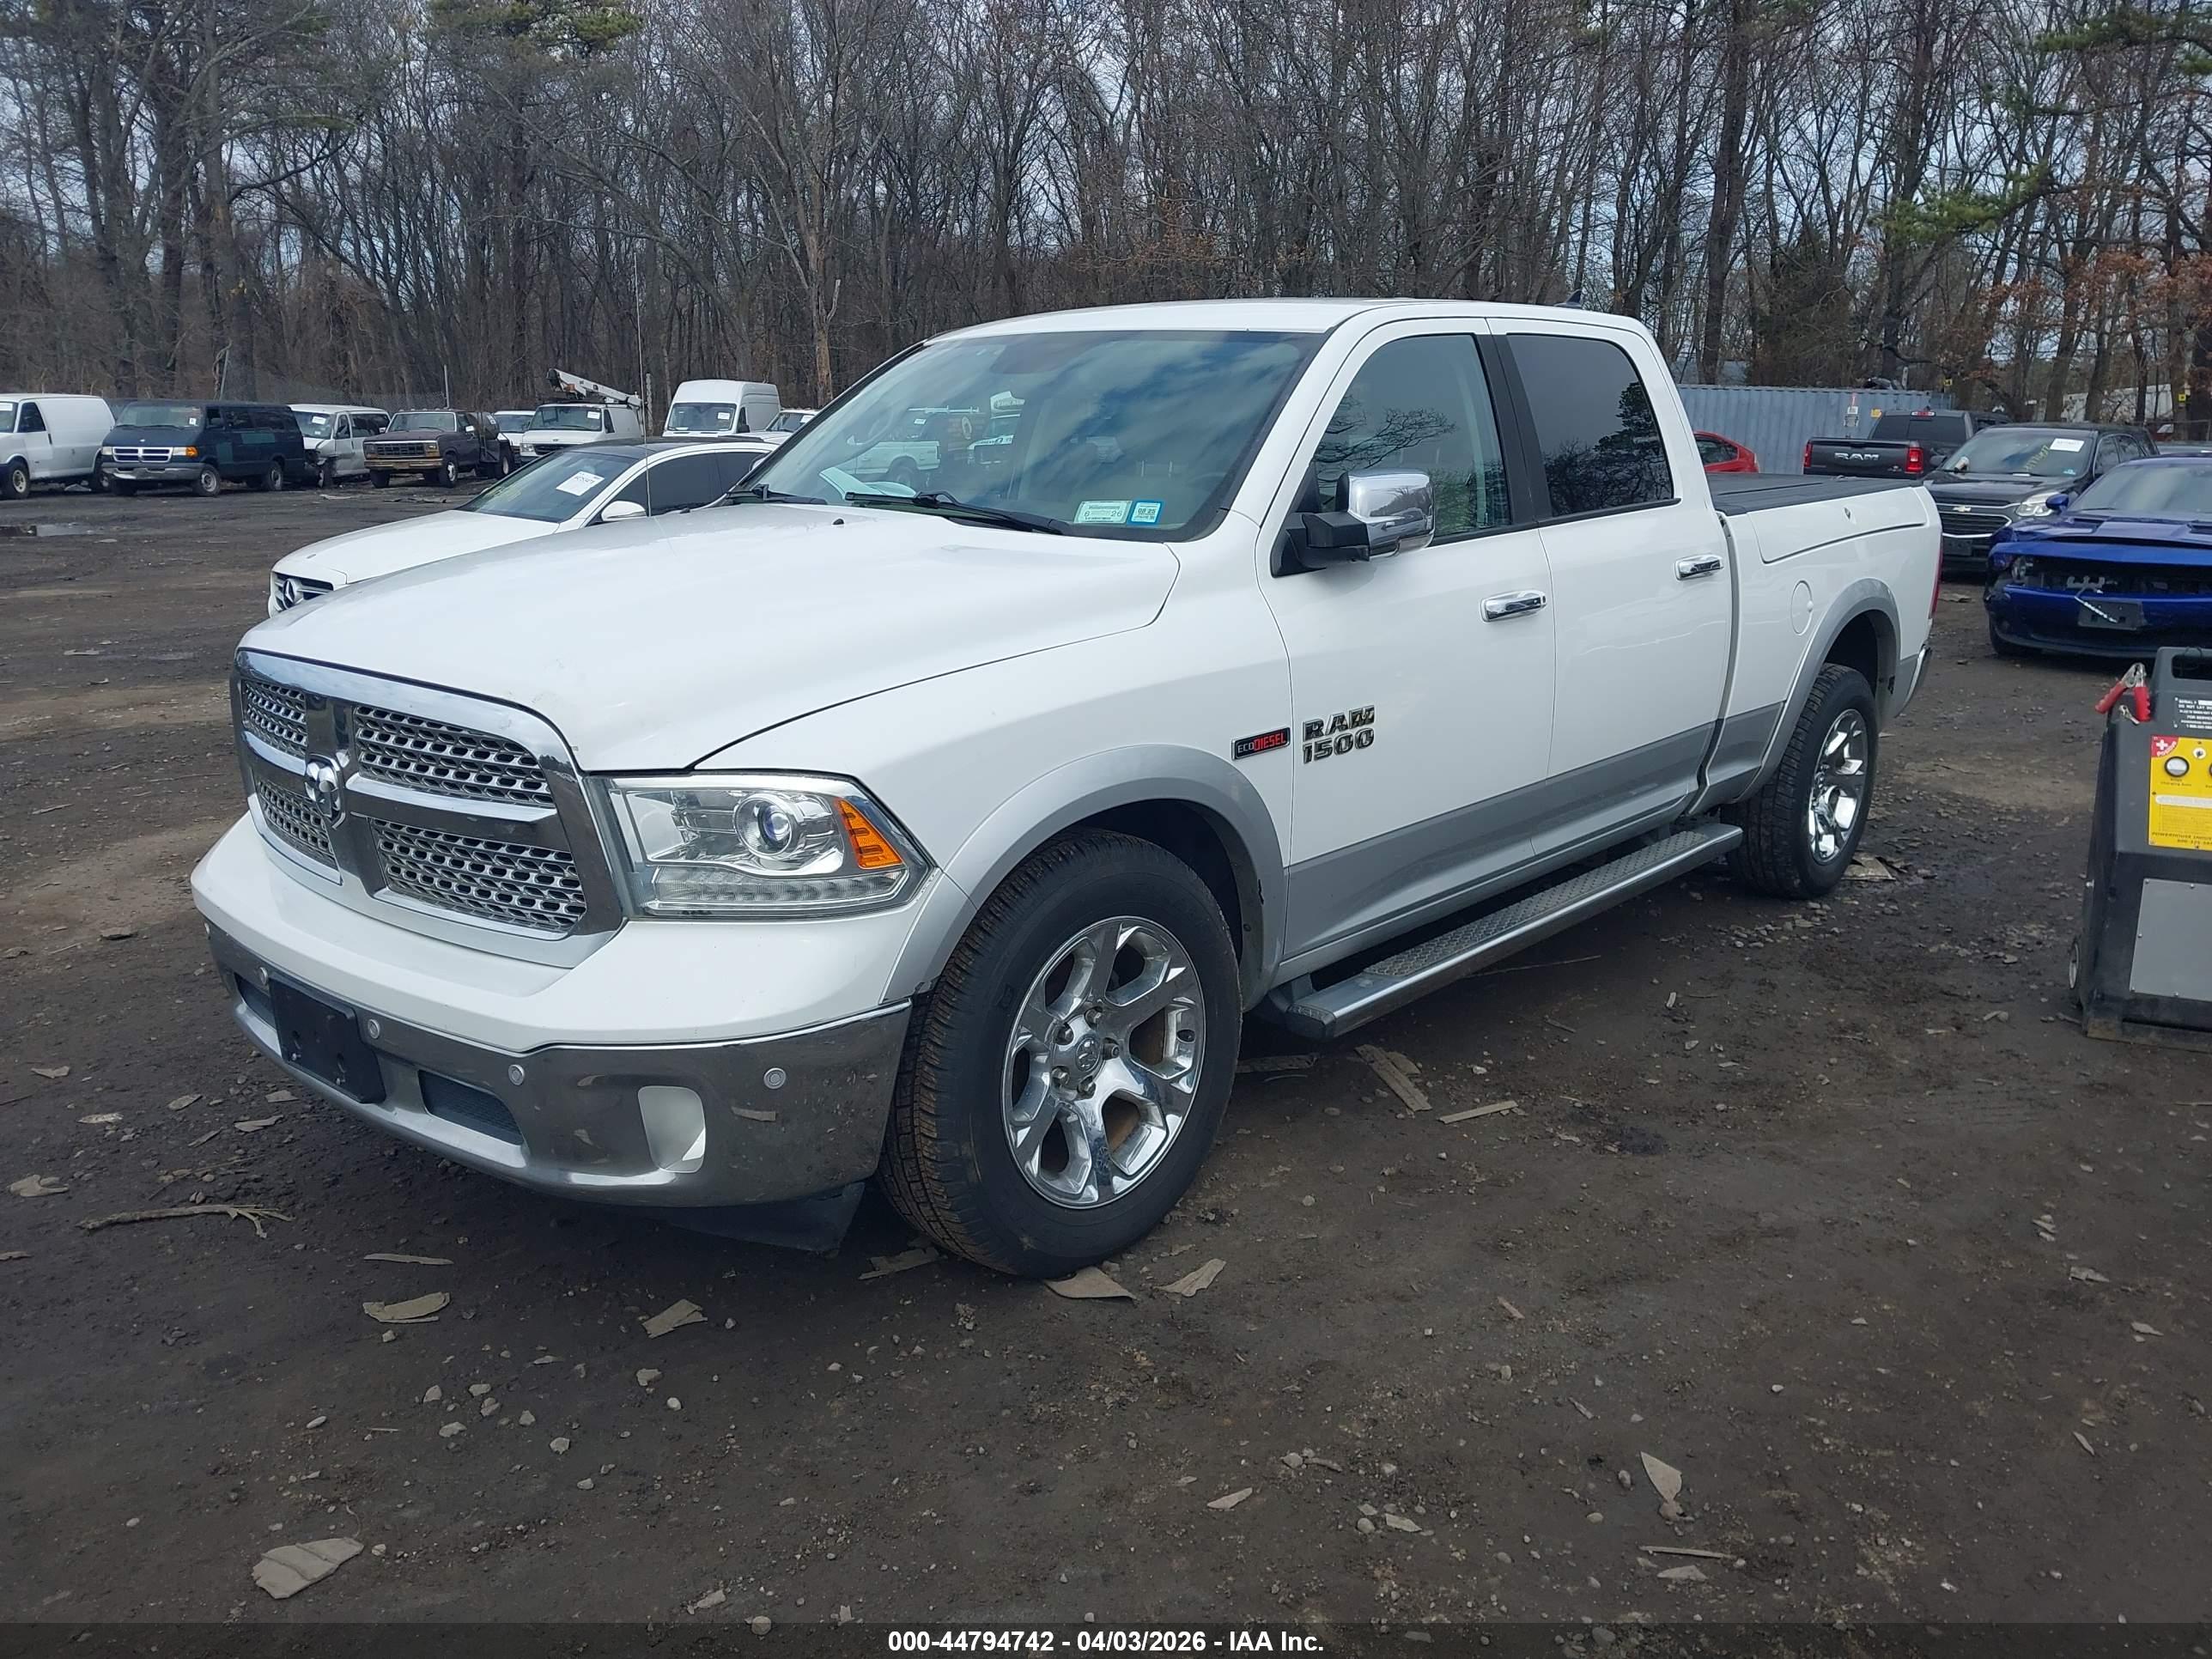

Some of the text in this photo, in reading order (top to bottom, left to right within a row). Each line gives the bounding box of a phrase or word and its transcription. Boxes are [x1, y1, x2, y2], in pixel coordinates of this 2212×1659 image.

[1834, 453, 1880, 461] RAM
[1302, 704, 1375, 742] RAM
[1302, 727, 1375, 764] 1500
